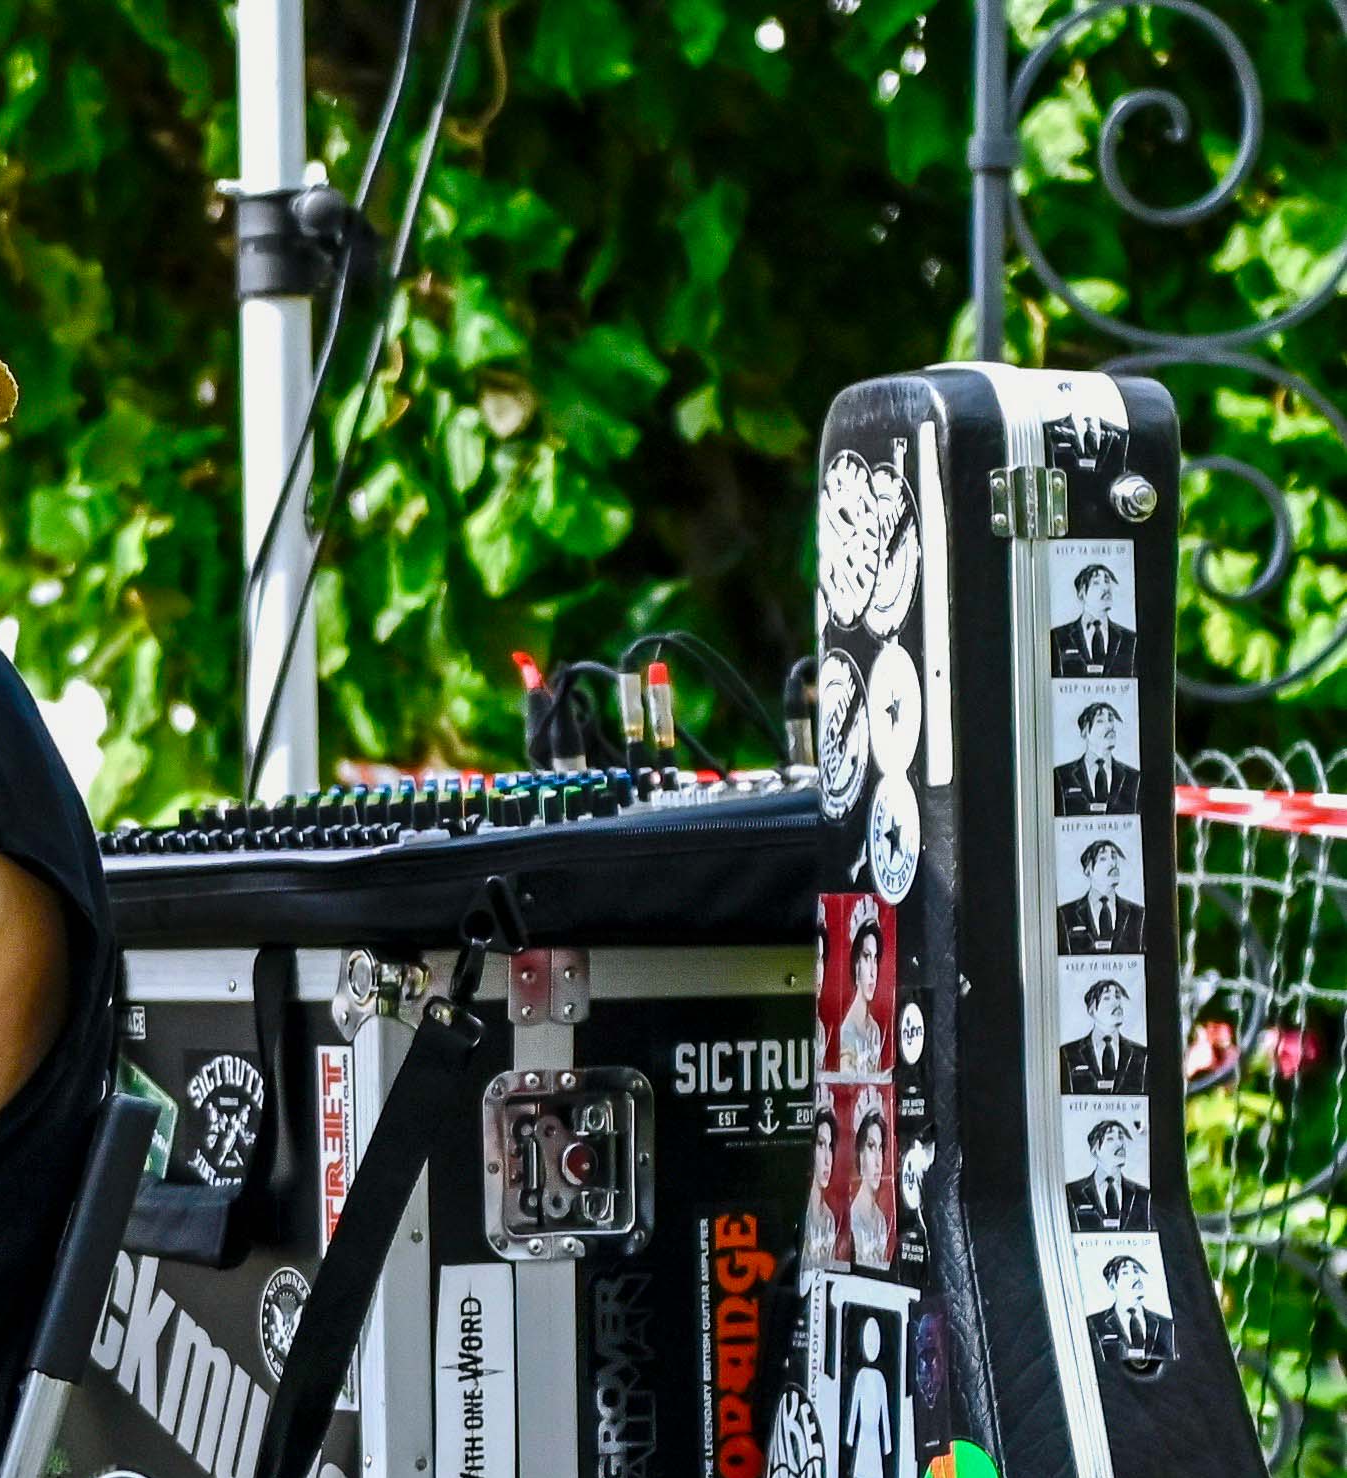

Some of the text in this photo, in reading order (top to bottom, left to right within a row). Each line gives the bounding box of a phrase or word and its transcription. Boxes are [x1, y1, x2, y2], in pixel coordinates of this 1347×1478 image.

[675, 1037, 819, 1094] SICTRU
[718, 1111, 737, 1127] EST
[700, 1218, 710, 1282] AMPLIFIER
[702, 1285, 711, 1330] GUITAR
[456, 1296, 484, 1384] WORD
[703, 1333, 712, 1380] BRITISH
[463, 1388, 485, 1431] ONE
[704, 1385, 713, 1456] LEGENDARY
